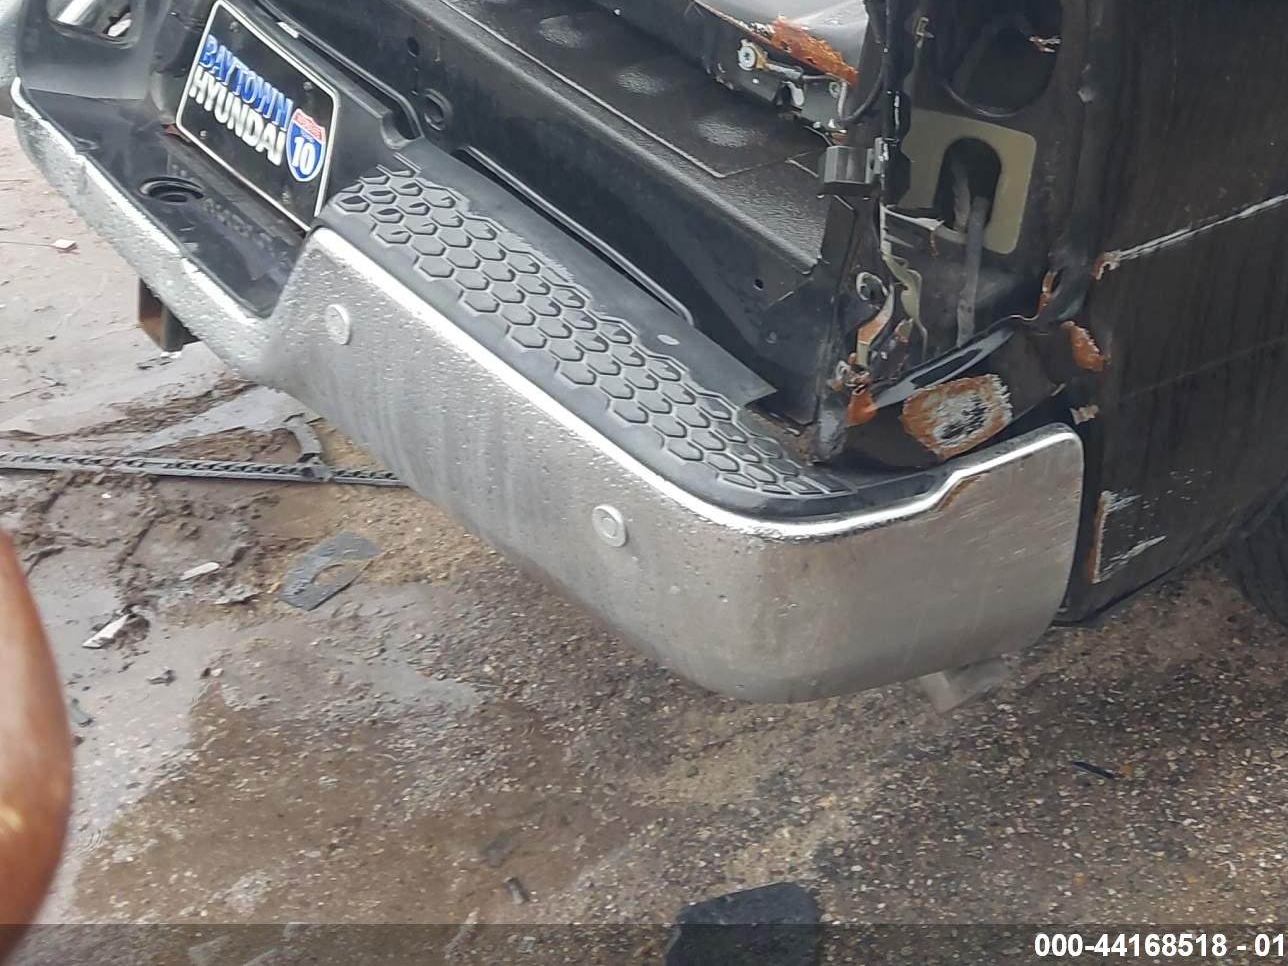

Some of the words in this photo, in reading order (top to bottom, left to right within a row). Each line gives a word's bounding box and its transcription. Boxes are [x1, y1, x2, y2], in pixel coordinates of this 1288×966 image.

[188, 65, 286, 166] HYUNDAI
[199, 33, 294, 131] BAYTOWN
[291, 136, 316, 176] 10
